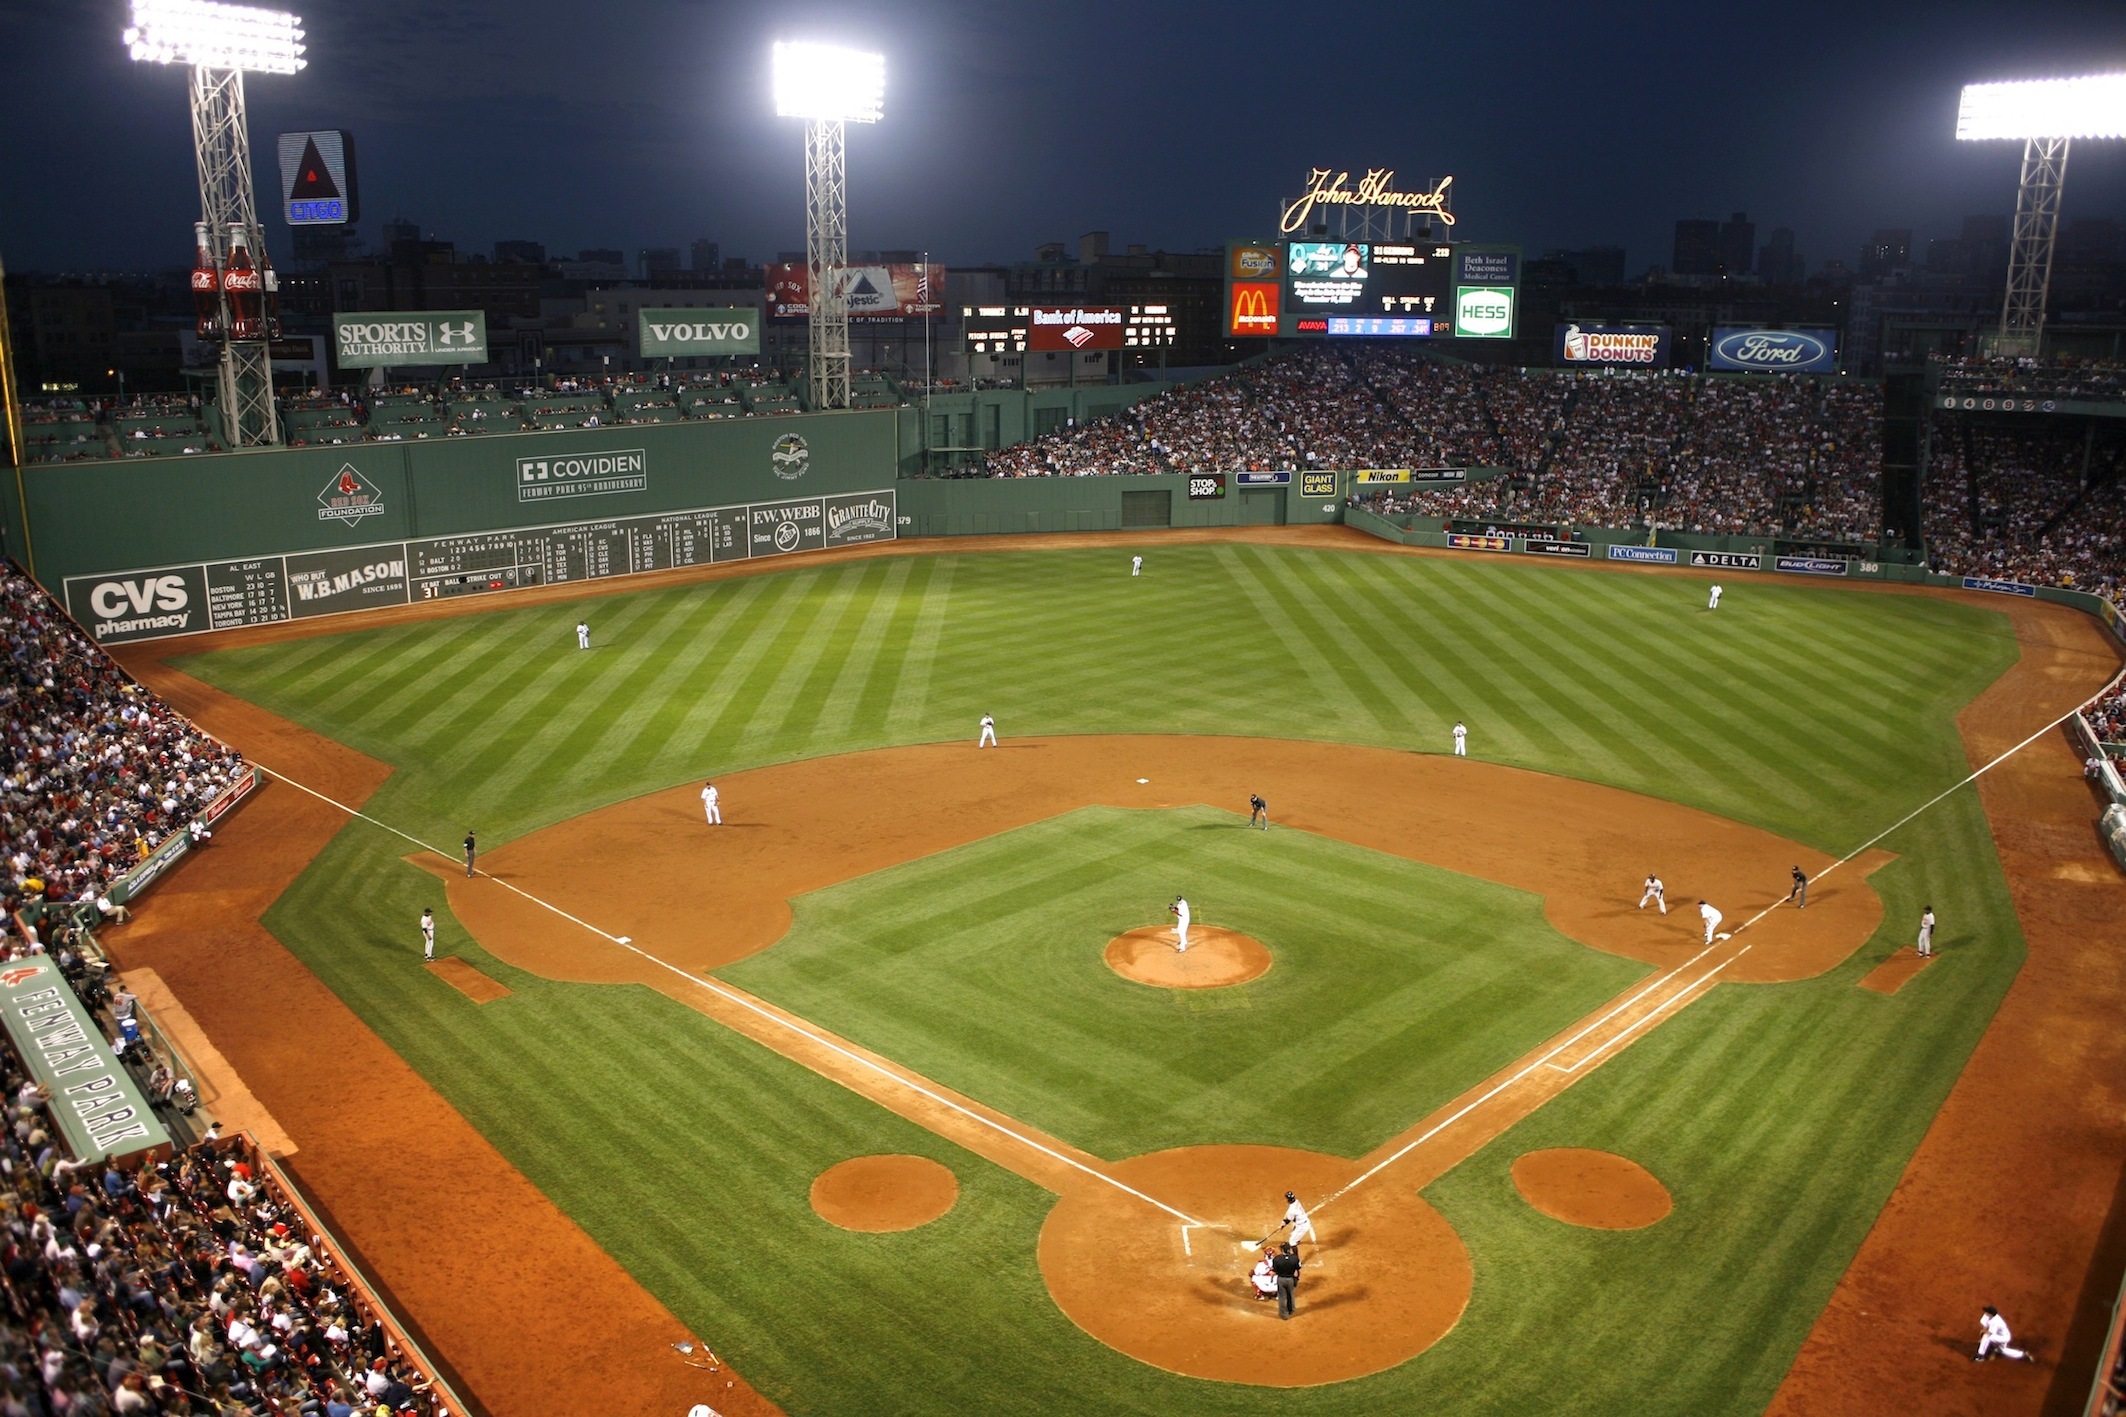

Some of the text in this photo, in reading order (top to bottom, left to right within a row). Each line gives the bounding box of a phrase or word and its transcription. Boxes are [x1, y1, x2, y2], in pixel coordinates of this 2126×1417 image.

[1281, 167, 1455, 232] John Hancock
[291, 201, 342, 220] CITGO
[1432, 248, 1450, 258] .213
[1242, 259, 1273, 268] Fusion
[1465, 256, 1483, 264] Beth
[1465, 264, 1507, 272] Deaconess
[787, 281, 802, 293] SOX
[1033, 309, 1062, 325] Bank
[1063, 310, 1076, 323] of
[1077, 310, 1122, 324] America
[1463, 305, 1506, 319] HESS
[1238, 315, 1276, 323] McDonald's
[1298, 321, 1327, 330] AVAYA
[339, 322, 426, 344] SPORTS
[650, 323, 750, 341] VOLVO
[1332, 324, 1349, 333] .213
[1355, 324, 1362, 333] 2
[1372, 324, 1379, 333] 9
[1389, 325, 1407, 333] .267
[1590, 335, 1658, 348] DUNKIN'
[342, 342, 426, 356] AUTHORITY
[1589, 348, 1653, 361] DONUTS
[1738, 335, 1805, 363] Ford
[2043, 402, 2055, 410] 42
[772, 433, 789, 450] BOSTON
[553, 455, 641, 478] COVIDIEN
[799, 463, 810, 477] FUND
[1305, 475, 1333, 484] GIANT
[1368, 471, 1399, 482] Nikon
[523, 478, 643, 498] FENWAY PARK 95th ANNIVERSARY
[1190, 487, 1215, 496] SHOP
[1304, 484, 1333, 493] GLASS
[331, 495, 370, 508] RED SOX
[321, 505, 382, 518] FOUNDATION
[753, 505, 821, 525] F.W. WEBB
[828, 499, 891, 529] GRANITE CITY
[1322, 504, 1336, 513] 420
[661, 512, 718, 523] NATIONAL LEAGUE
[552, 523, 617, 535] AMERICAN LEAGUE
[753, 534, 771, 544] Since
[804, 527, 821, 537] 1866
[434, 538, 479, 548] FENWAY
[1545, 544, 1570, 553] verizon
[430, 557, 445, 565] BALT
[1613, 547, 1673, 562] PC Connection
[1709, 554, 1758, 567] DELTA
[243, 563, 261, 571] EAST
[427, 565, 449, 574] BOSTON
[1779, 560, 1842, 570] BUD LIGHT
[1860, 562, 1879, 573] 380
[265, 571, 276, 579] GB
[291, 571, 326, 583] WHO BUT
[444, 572, 503, 586] BALL STRIKE OUT
[210, 585, 235, 595] BOSTON
[246, 582, 255, 591] 23
[362, 583, 403, 594] SINCE 1898
[423, 587, 438, 599] 31
[90, 575, 188, 619] CVS
[211, 590, 265, 603] BALTIMORE 17 18
[212, 598, 266, 612] NEW YORK 16 17
[213, 606, 268, 620] TAMPA BAY 14 20
[95, 611, 190, 639] pharmacy
[214, 613, 279, 628] TORONTO 13 21 10
[12, 986, 105, 1077] FENWAY
[64, 1074, 149, 1151] PARK
